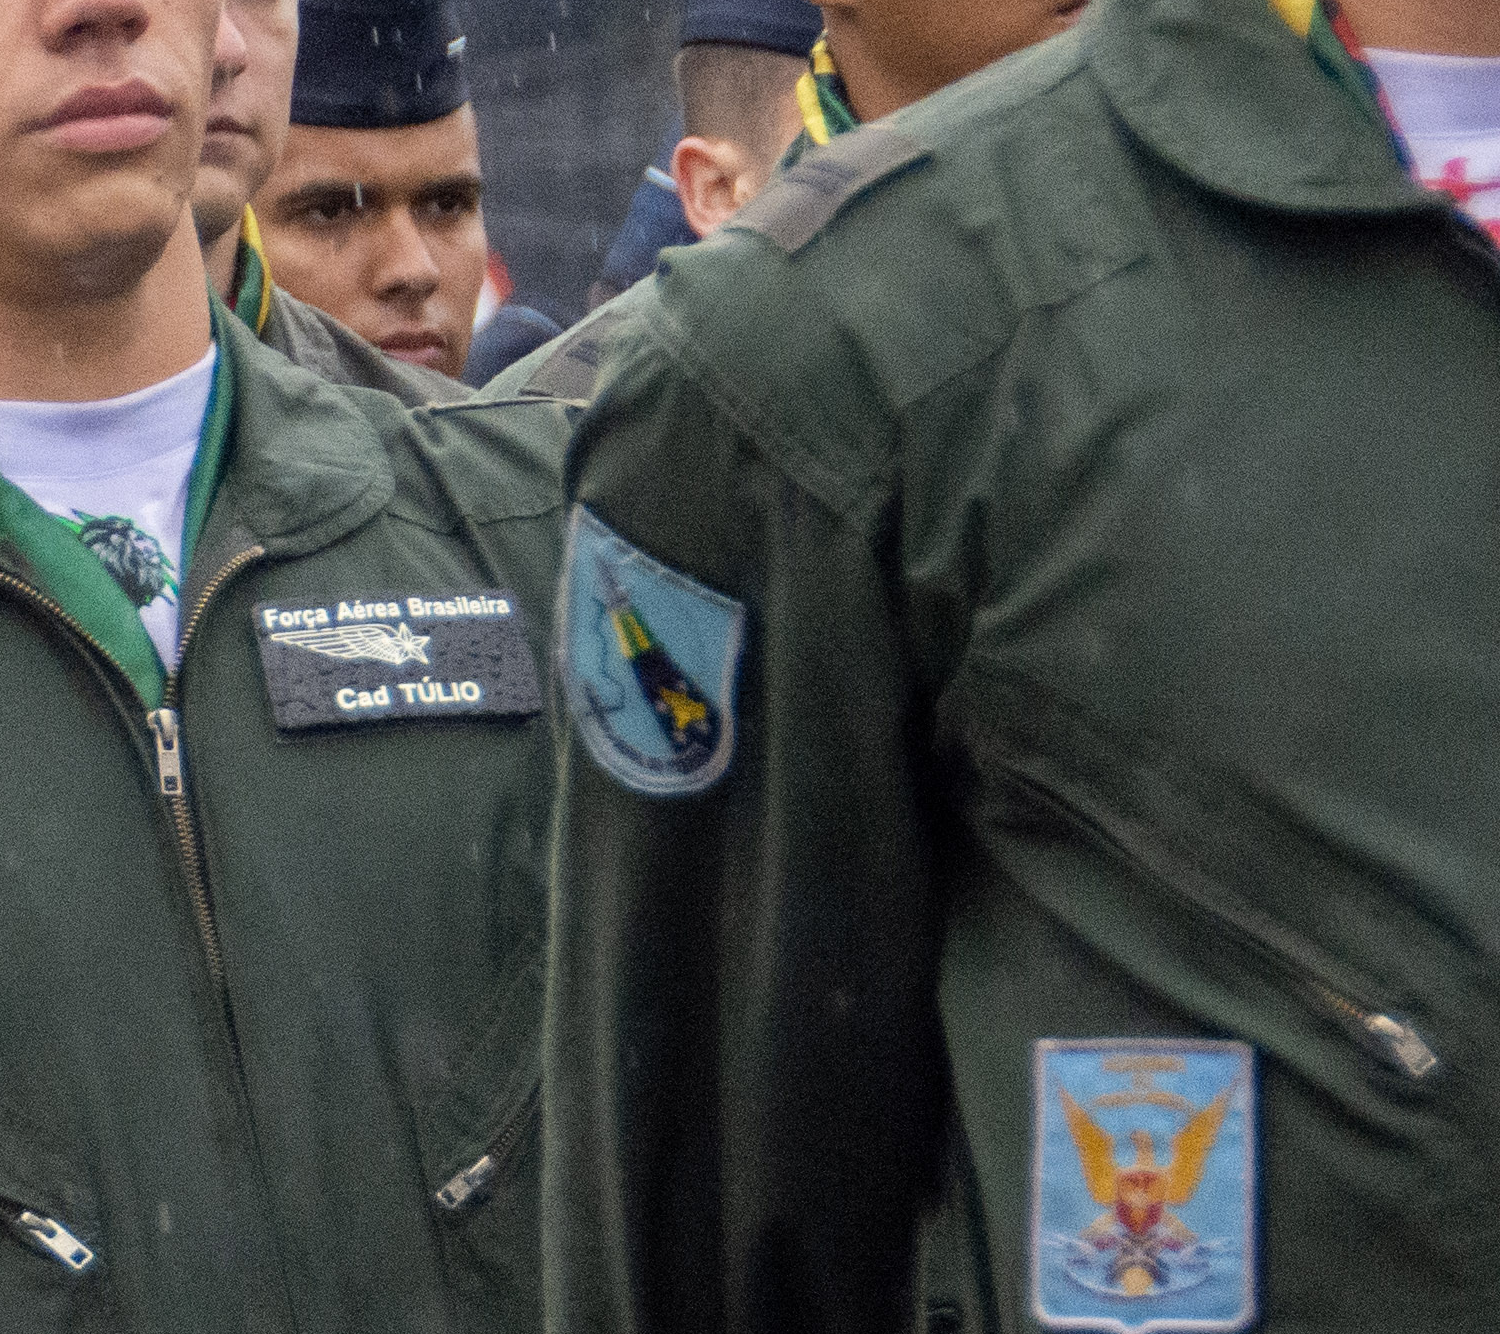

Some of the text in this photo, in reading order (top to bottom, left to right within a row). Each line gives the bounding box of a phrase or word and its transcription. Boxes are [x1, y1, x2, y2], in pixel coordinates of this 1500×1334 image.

[263, 596, 510, 628] Força Aérea Brasileira
[336, 675, 481, 709] Cad TÚLIO
